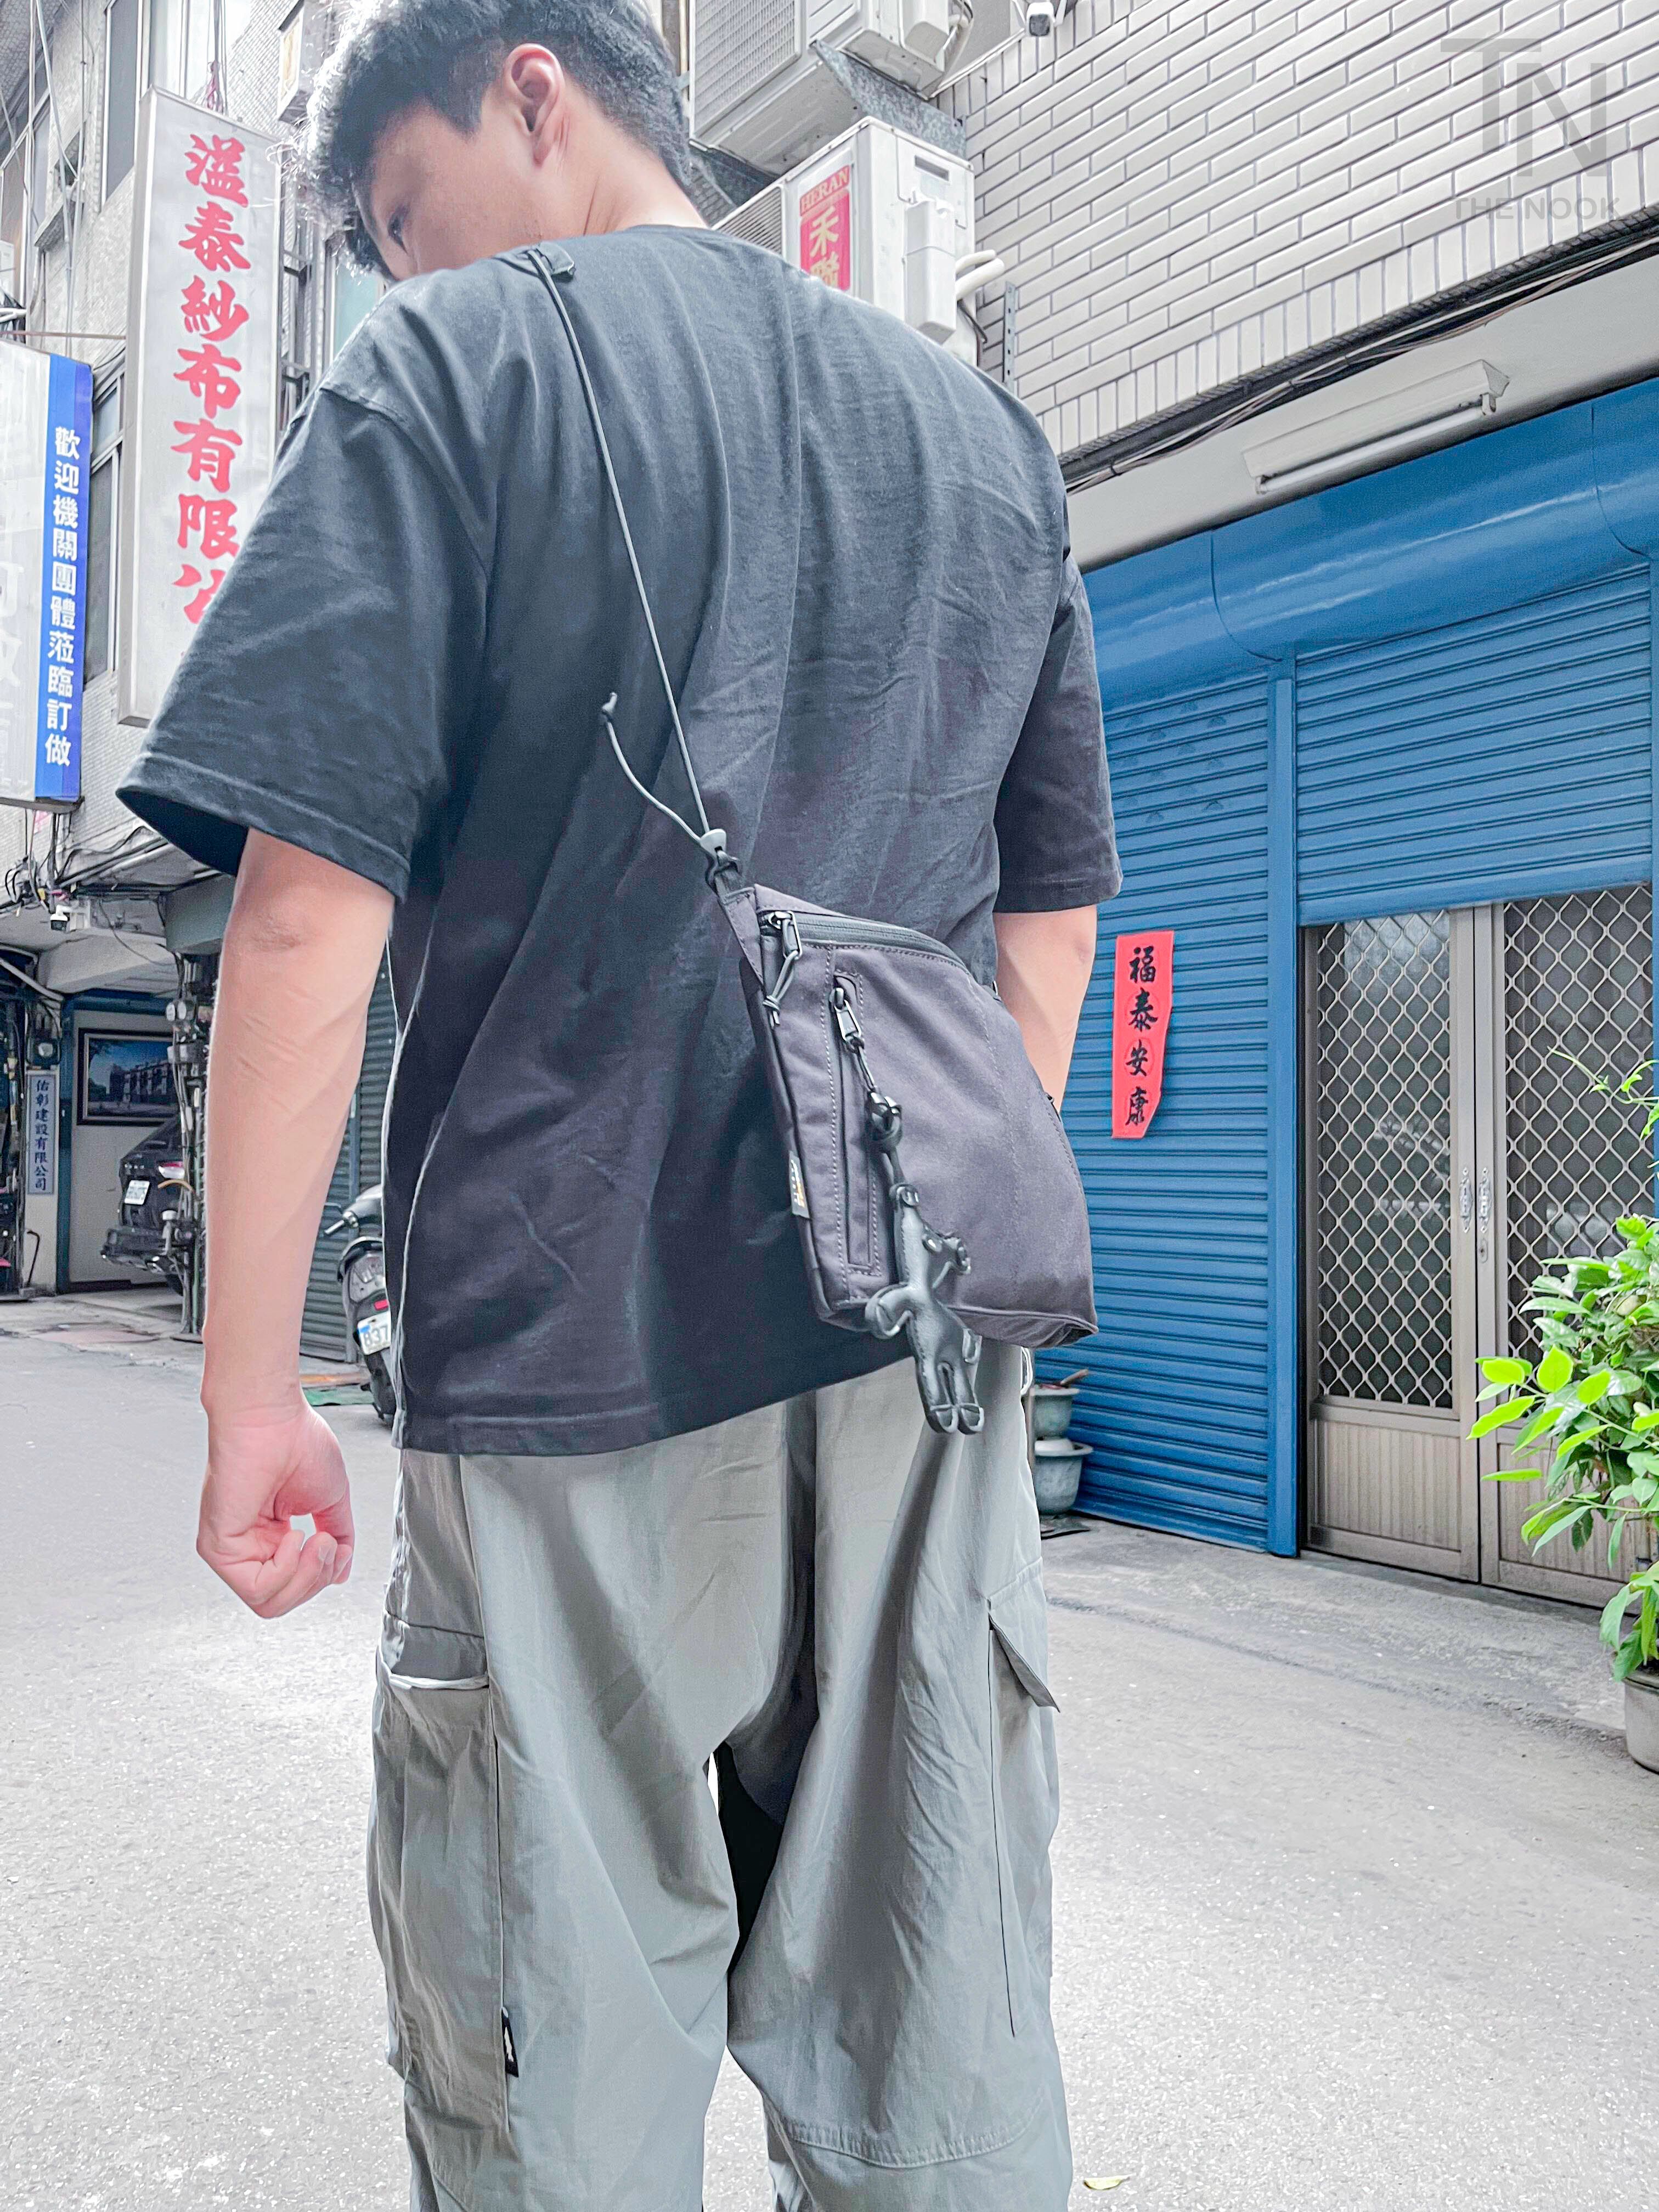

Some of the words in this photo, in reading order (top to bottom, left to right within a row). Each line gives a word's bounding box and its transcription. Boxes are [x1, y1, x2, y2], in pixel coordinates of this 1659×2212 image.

[800, 166, 850, 215] HERAN
[45, 426, 81, 767] 歡迎機關團體蒞臨訂做
[1125, 945, 1158, 1126] 福泰安康
